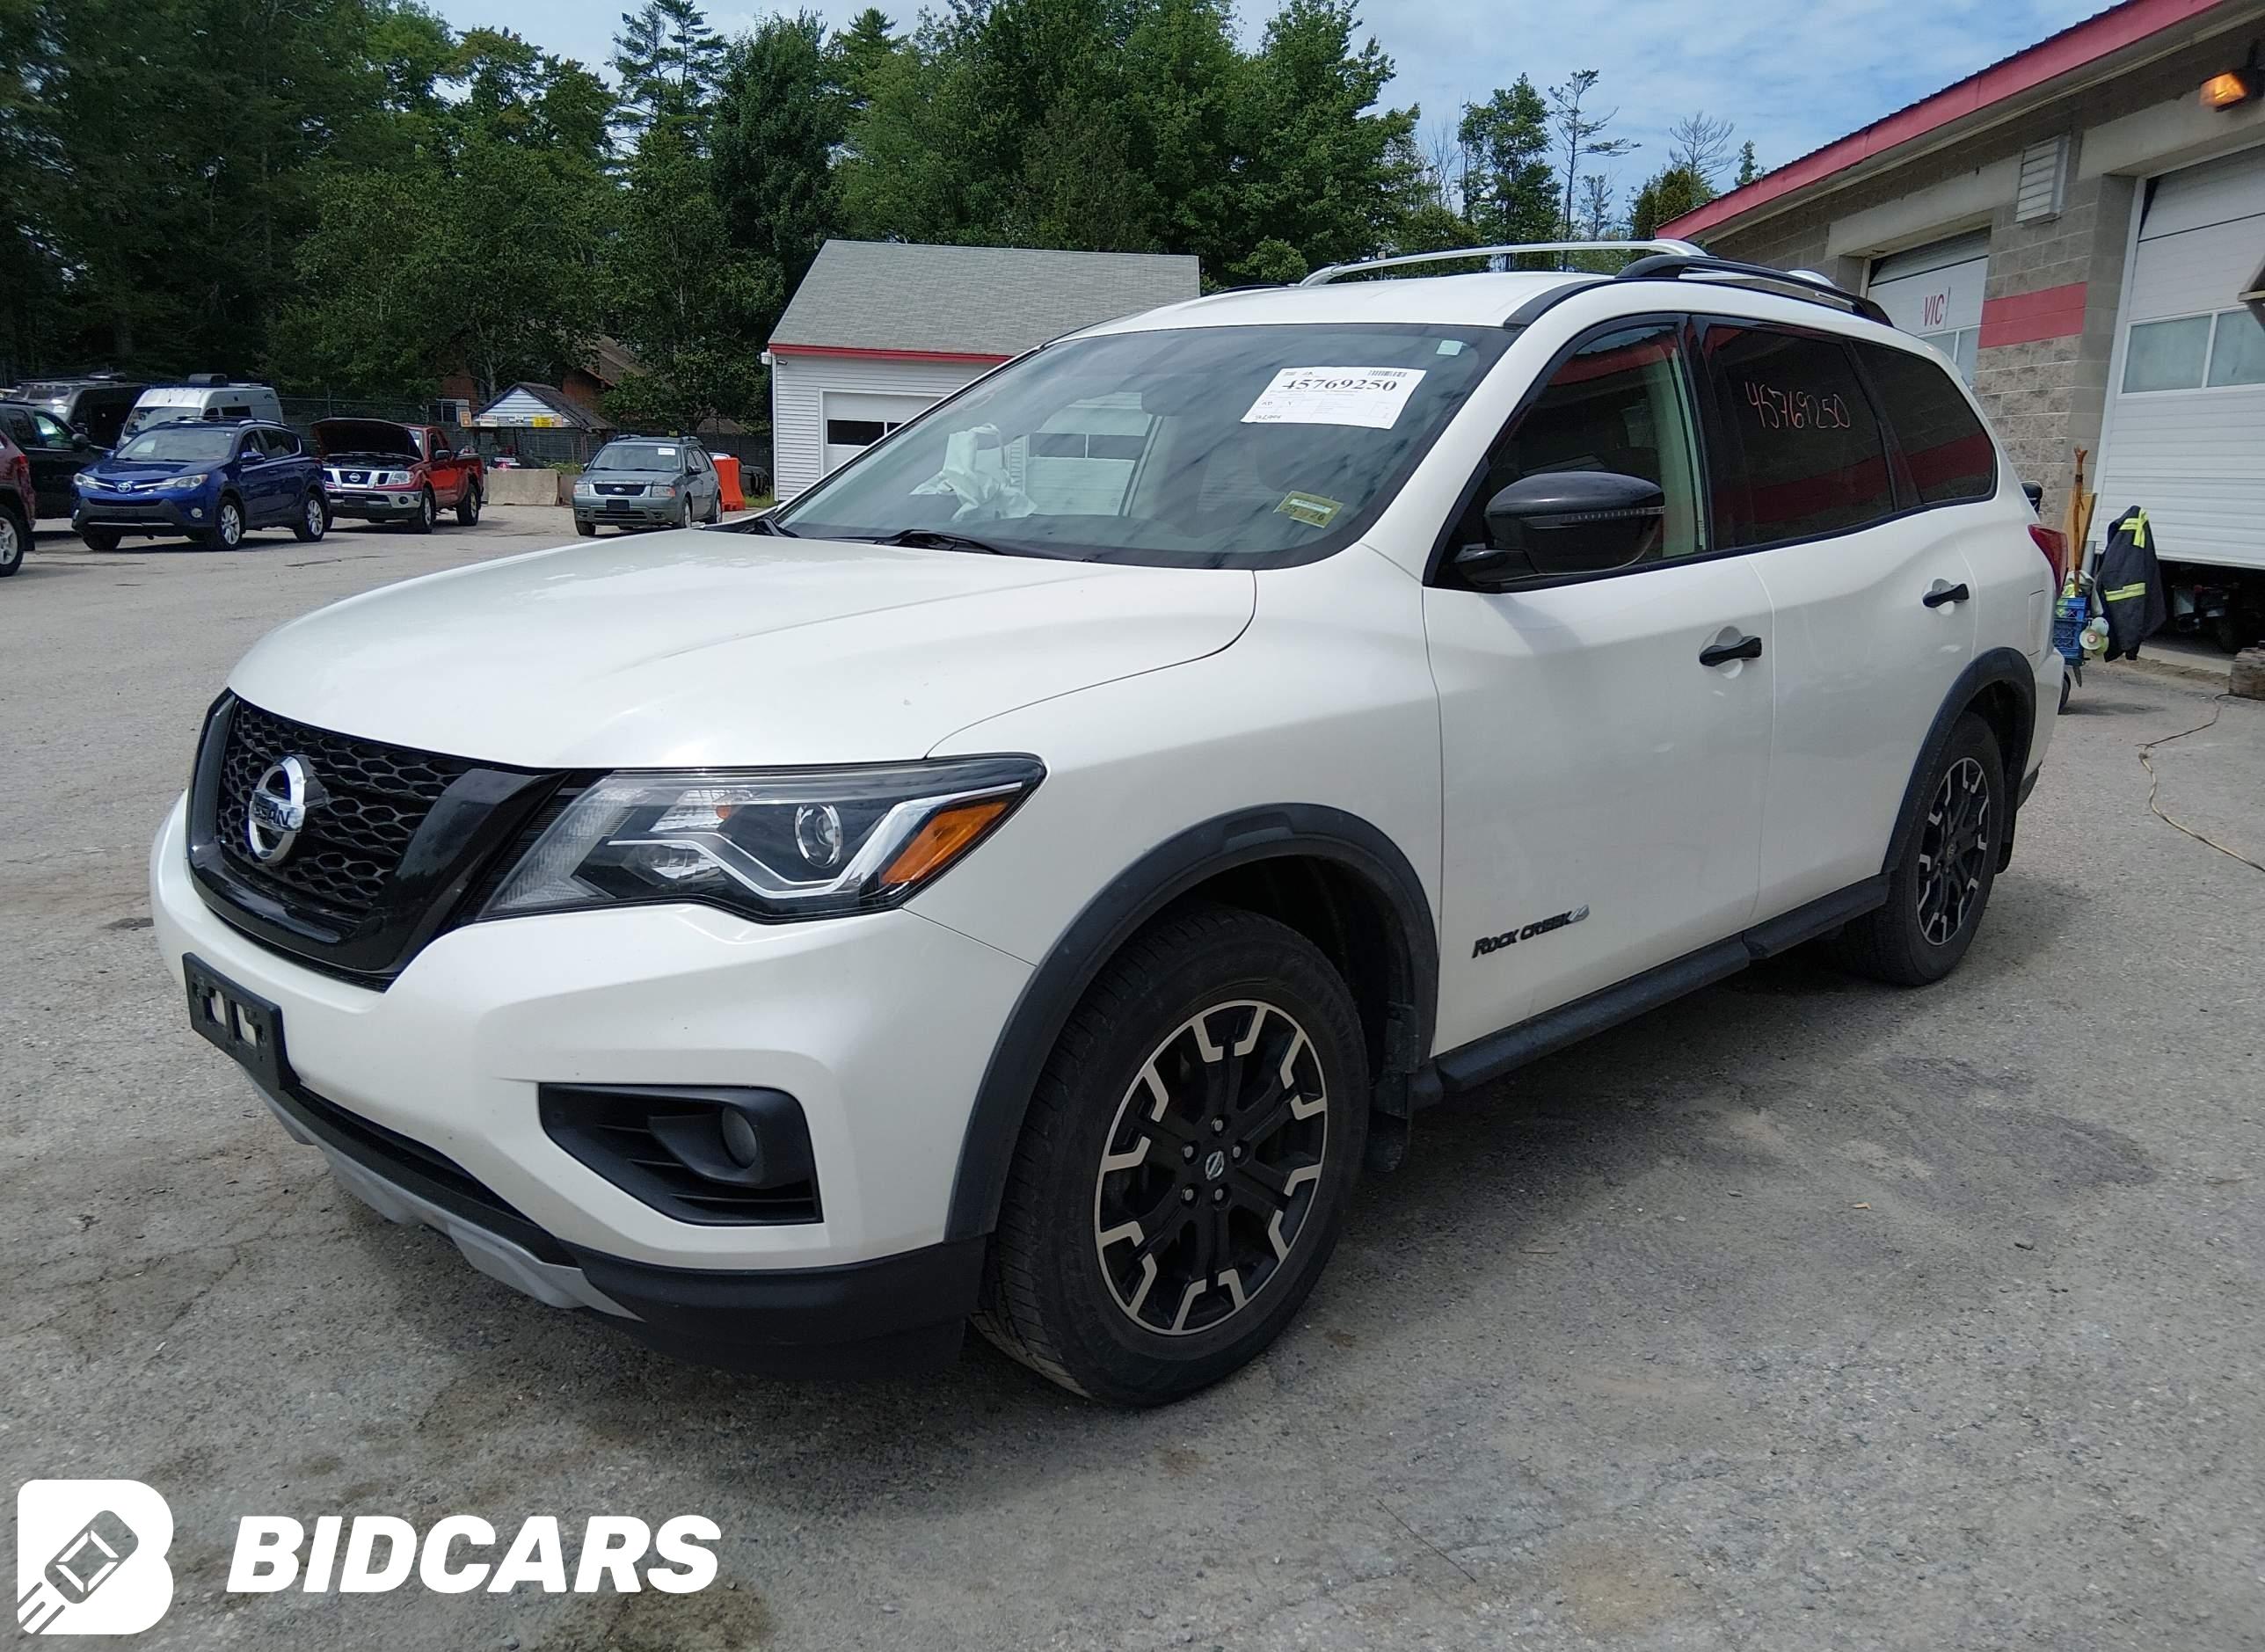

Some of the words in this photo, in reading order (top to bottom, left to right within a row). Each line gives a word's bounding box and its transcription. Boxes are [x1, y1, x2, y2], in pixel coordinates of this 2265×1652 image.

[1281, 379, 1398, 392] 45769250
[1744, 382, 1851, 429] 45769250
[1471, 928, 1519, 958] ROCK
[1520, 911, 1572, 941] CREEK
